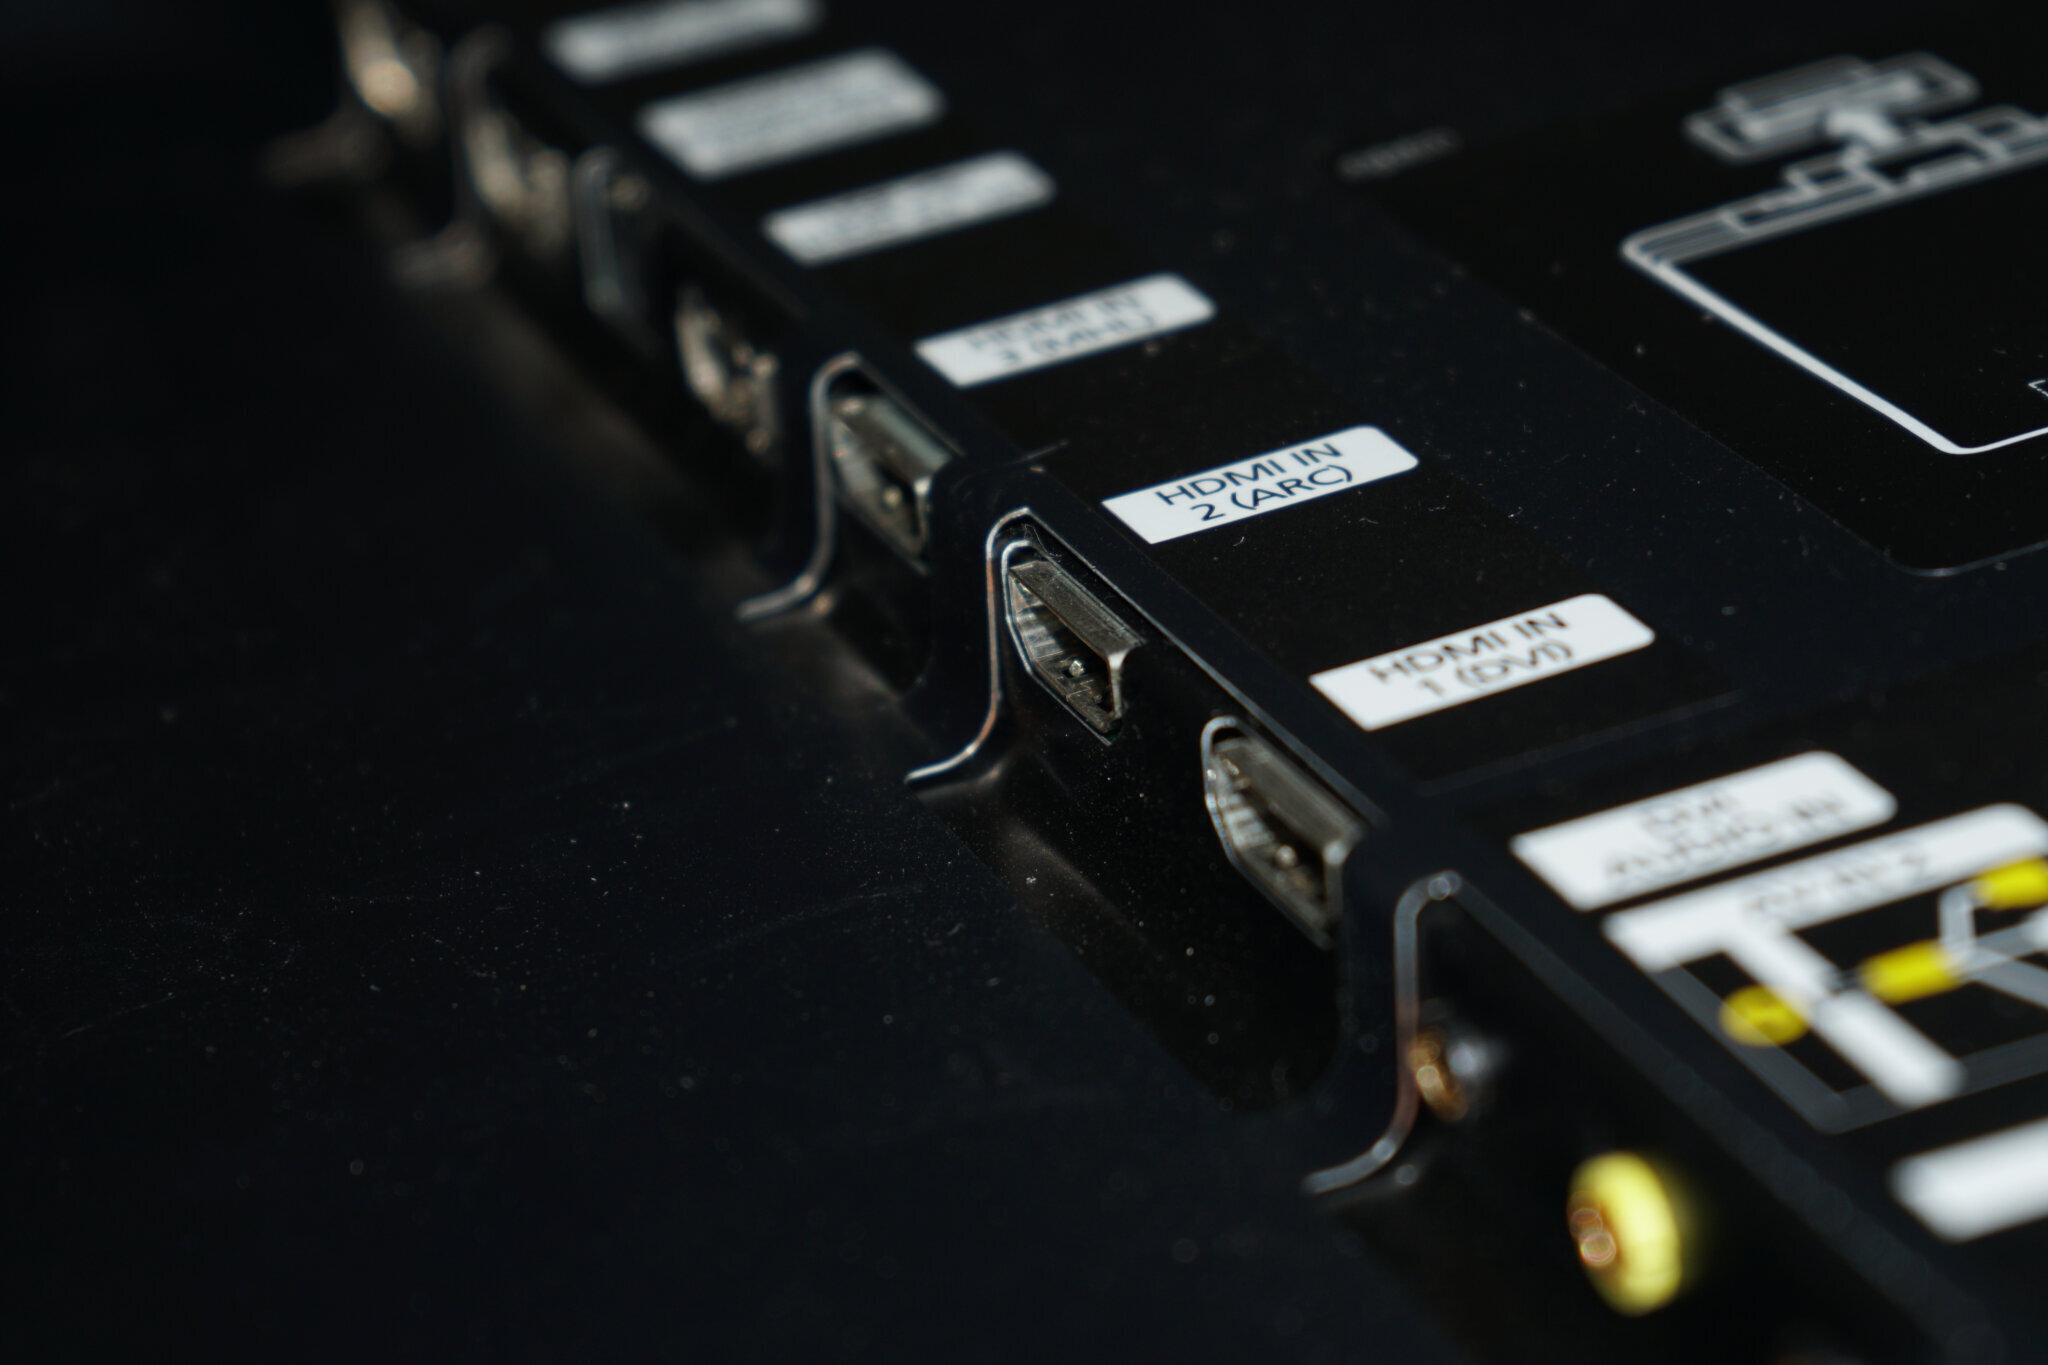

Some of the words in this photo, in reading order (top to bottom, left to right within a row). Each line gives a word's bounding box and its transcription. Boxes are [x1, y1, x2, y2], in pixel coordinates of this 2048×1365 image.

[1155, 459, 1287, 505] HDMI
[1291, 443, 1344, 467] IN
[1191, 503, 1226, 521] 2
[1231, 464, 1353, 510] (ARC)
[1368, 630, 1509, 683] HDMI
[1513, 612, 1569, 640] IN
[1418, 678, 1447, 697] 1
[1455, 639, 1574, 688] (DVI)
